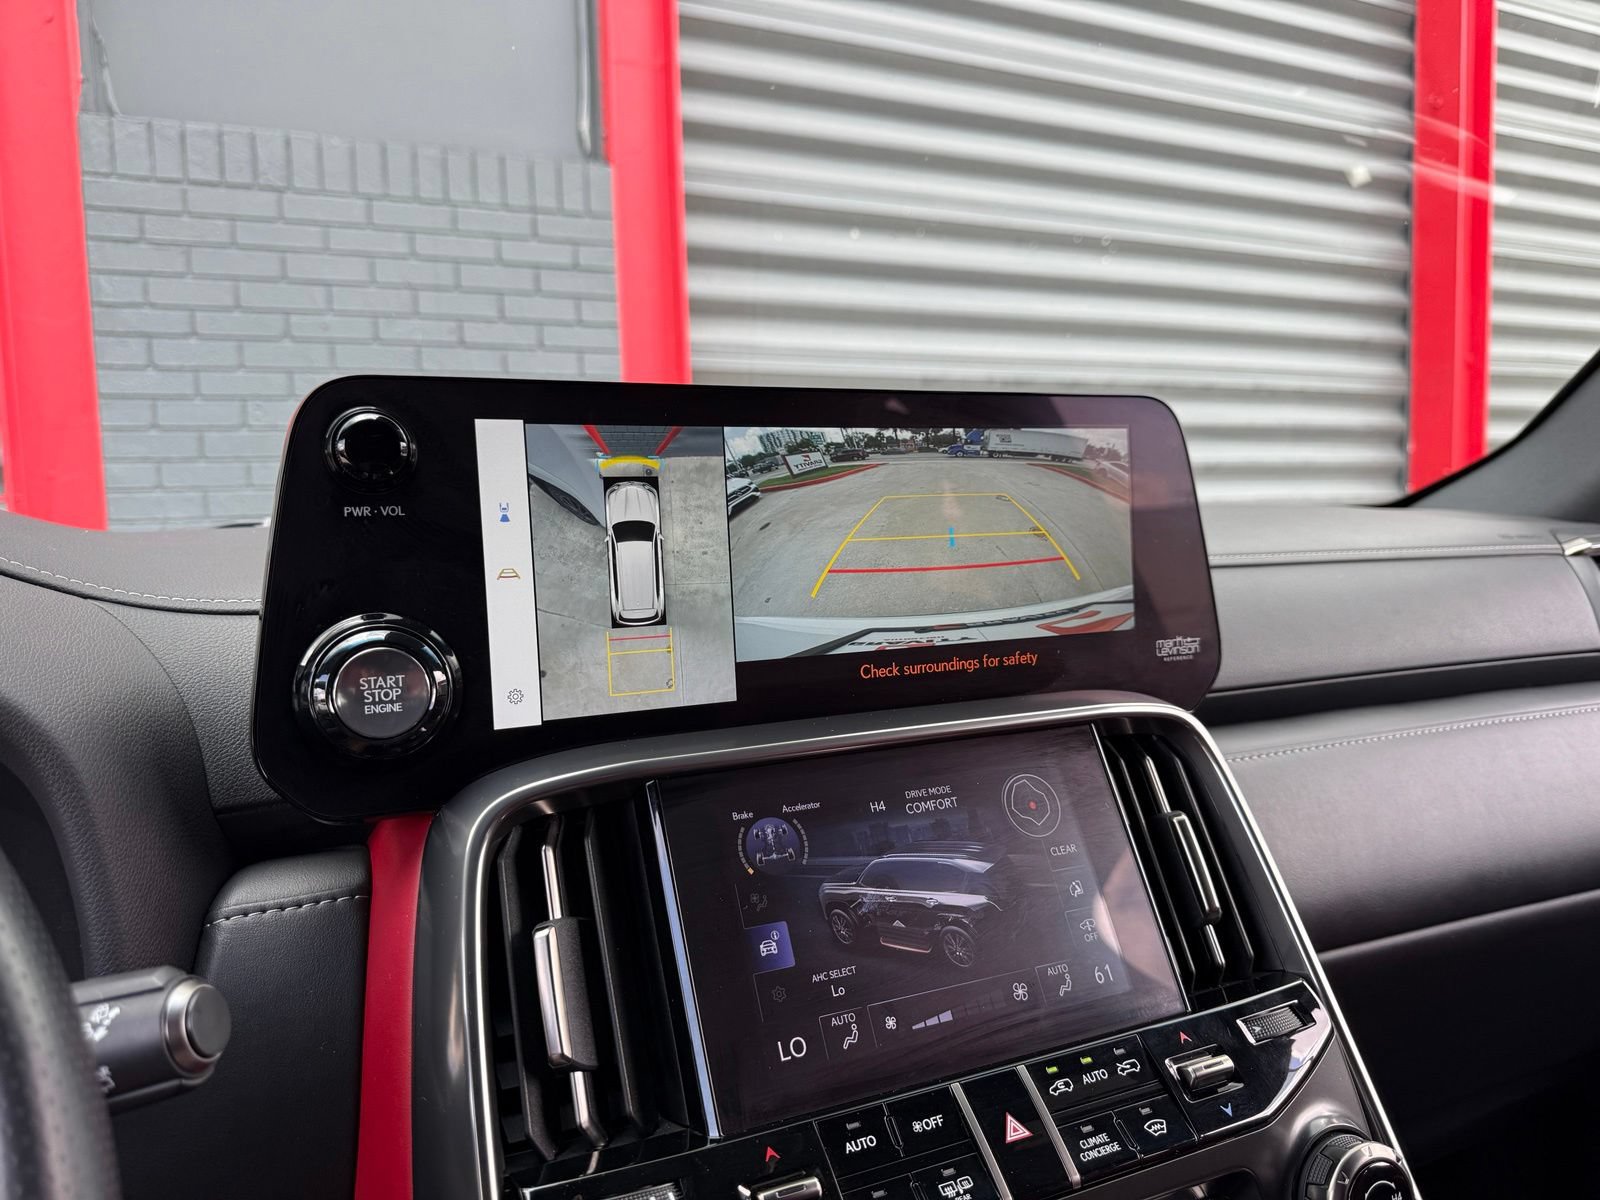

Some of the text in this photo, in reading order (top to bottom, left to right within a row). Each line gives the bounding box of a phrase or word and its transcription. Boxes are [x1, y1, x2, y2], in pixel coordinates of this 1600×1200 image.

[344, 505, 406, 517] PWR VOL
[860, 651, 1039, 680] Check surroundings for safety
[359, 674, 406, 690] START
[363, 689, 402, 703] STOP
[364, 702, 403, 715] ENGINE
[905, 785, 952, 799] DRIVE MODE
[782, 801, 821, 814] Accelerator
[869, 800, 886, 813] H4
[905, 796, 958, 815] COMFORT
[732, 810, 754, 821] Brake
[1050, 843, 1077, 857] CLEAR
[1084, 931, 1099, 943] OFF
[812, 965, 857, 984] AHC SELECT
[1047, 963, 1069, 976] AUTO
[1094, 963, 1114, 985] 61
[830, 984, 846, 998] Lo
[831, 1012, 856, 1027] AUTO
[777, 1036, 807, 1062] LO
[1082, 1069, 1109, 1086] AUTO
[922, 1114, 944, 1130] OFF
[845, 1135, 877, 1154] AUTO
[1079, 1132, 1111, 1150] CLIMATE
[1079, 1142, 1122, 1162] CONCIERGE
